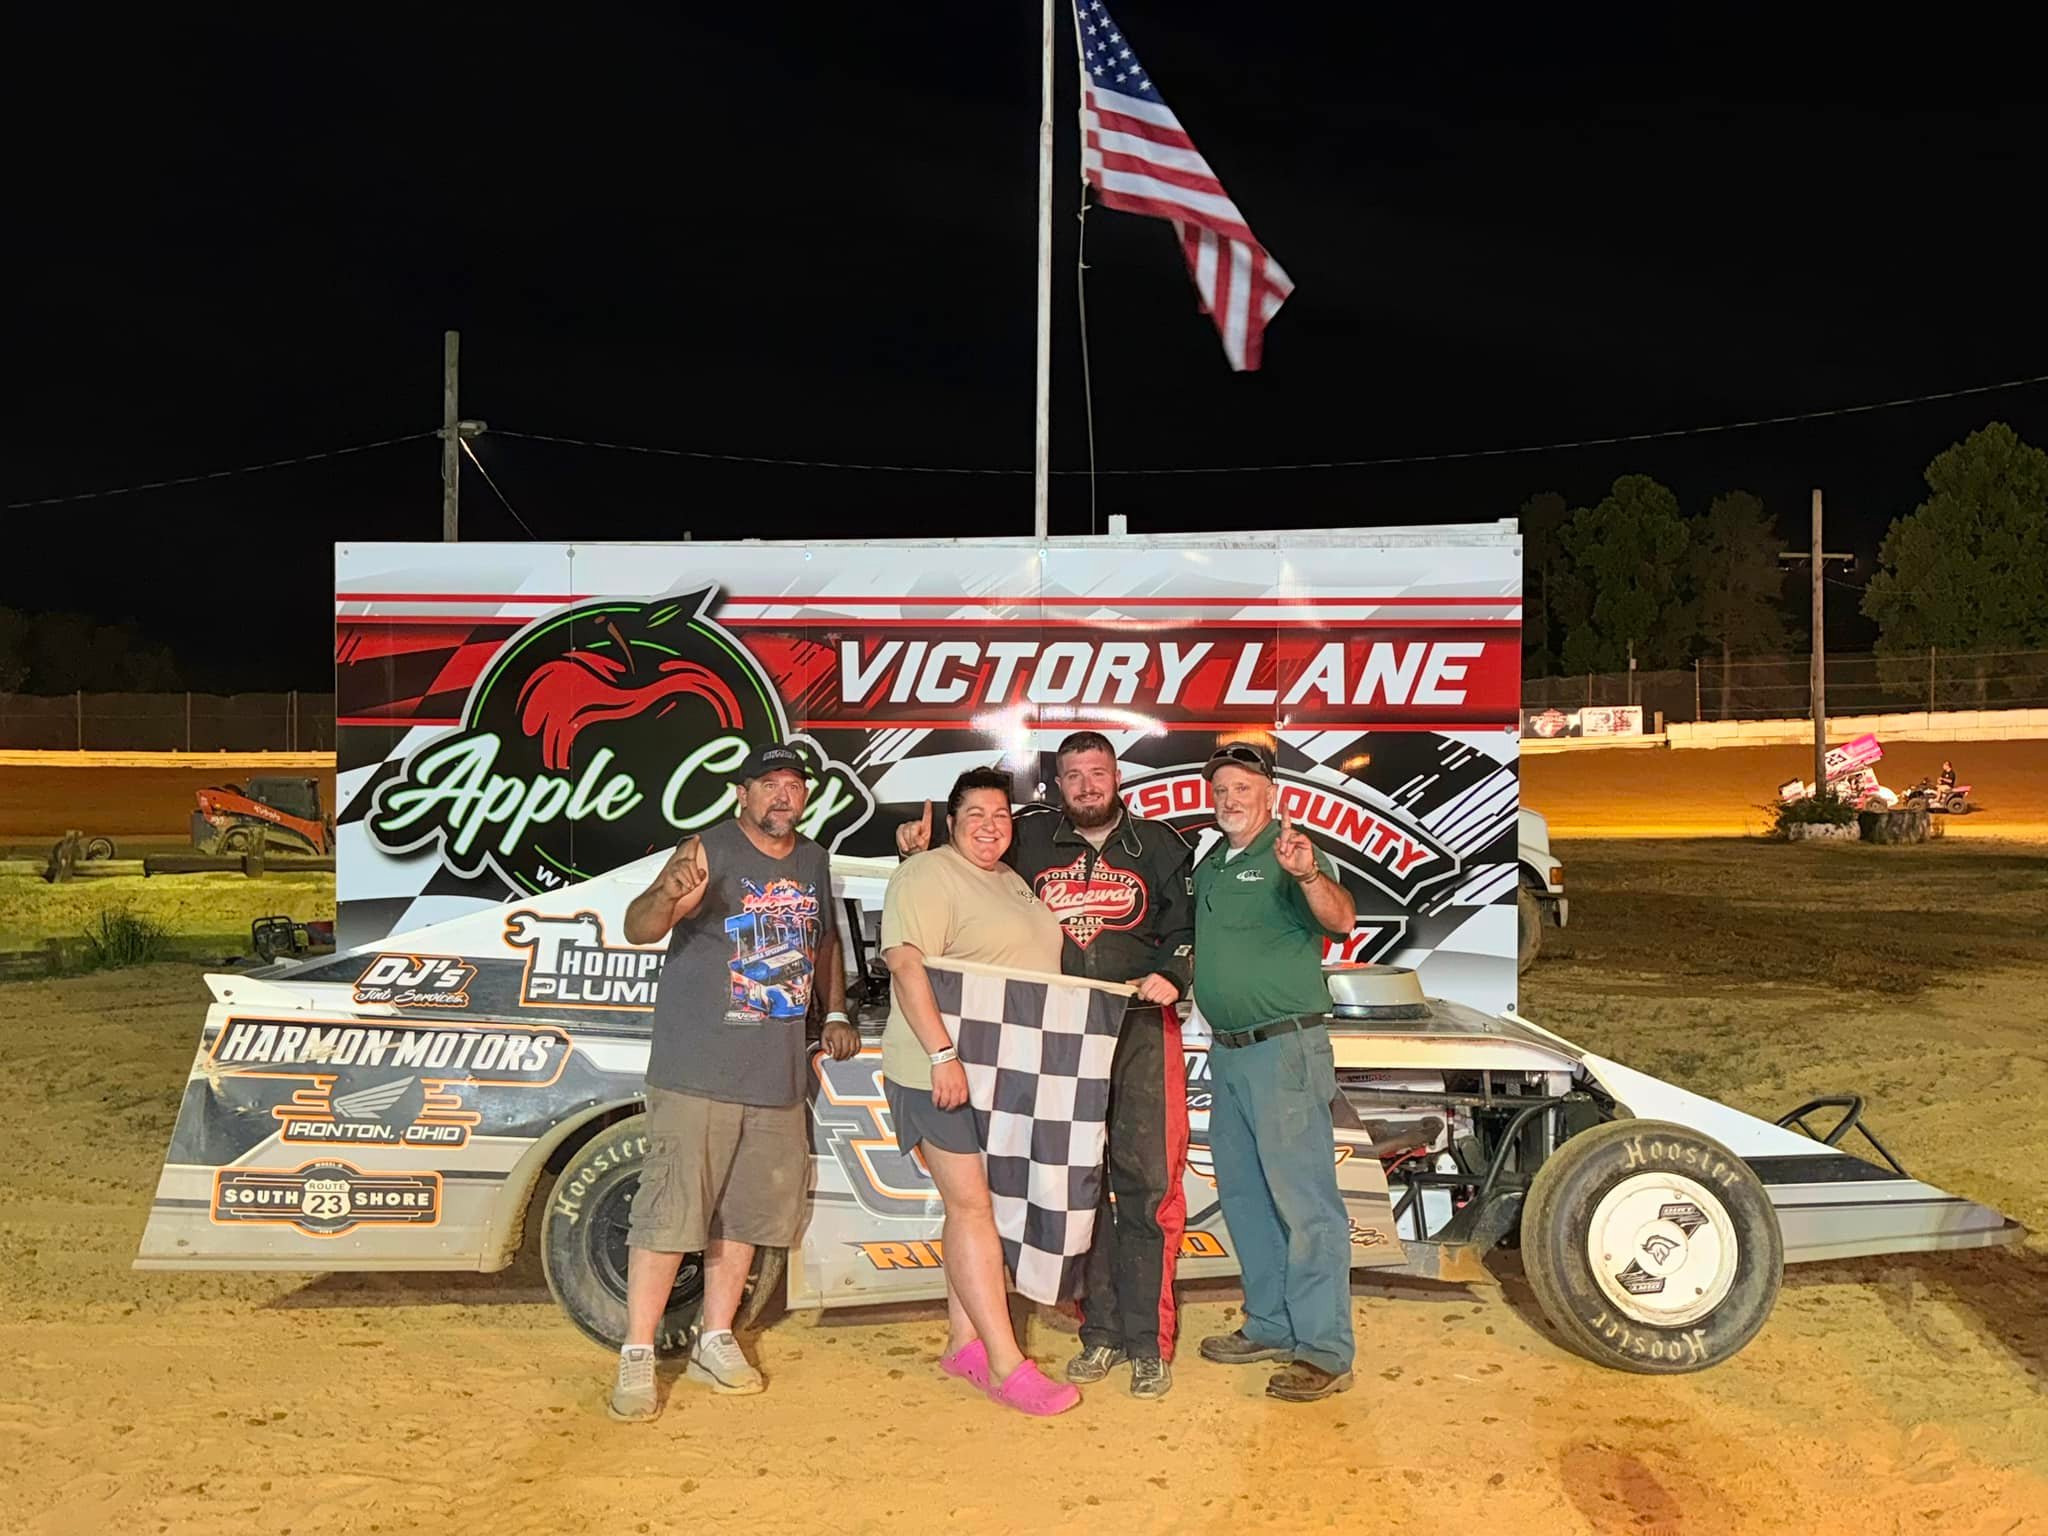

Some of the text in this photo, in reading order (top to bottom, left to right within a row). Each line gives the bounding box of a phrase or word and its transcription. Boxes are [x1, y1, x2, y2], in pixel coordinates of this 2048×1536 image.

[840, 641, 1486, 705] VICTORY LANE
[379, 732, 643, 856] Apple
[1277, 786, 1428, 873] OUNTY
[1042, 883, 1139, 908] Raceway
[1069, 916, 1104, 926] PARK
[361, 958, 466, 988] DJ's
[355, 987, 464, 1003] Tint Services
[529, 976, 659, 1004] PLUM
[220, 1024, 557, 1072] HARMON MOTORS
[287, 1121, 461, 1142] IRONTON, OHIO
[1621, 1135, 1740, 1186] Hoosier
[309, 1181, 345, 1191] ROUTE
[554, 1134, 649, 1225] Hoosier
[224, 1188, 430, 1207] SOUTH SHORE
[310, 1195, 342, 1214] 23
[1592, 1312, 1708, 1365] Hoosier
